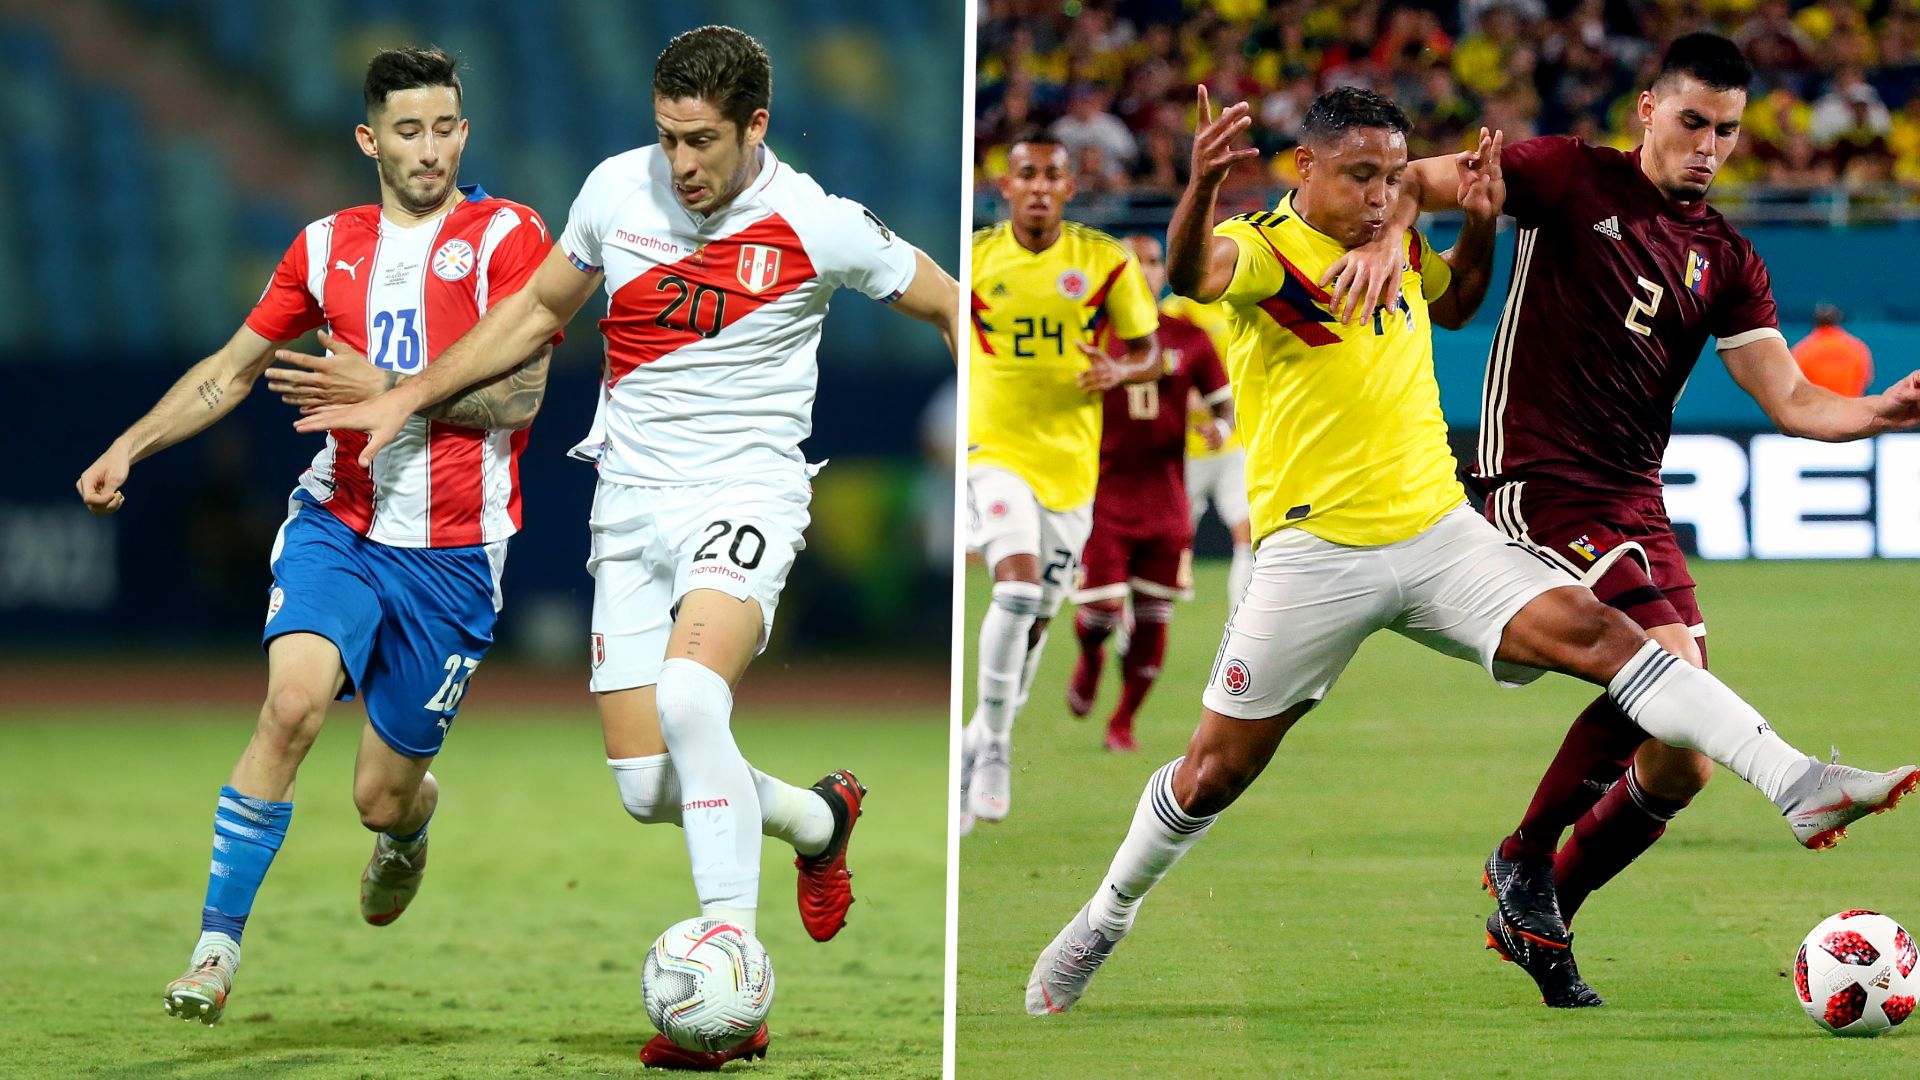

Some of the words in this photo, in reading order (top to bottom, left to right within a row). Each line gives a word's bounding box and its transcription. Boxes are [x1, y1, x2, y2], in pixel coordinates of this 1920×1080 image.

[616, 228, 678, 254] marathon
[1593, 223, 1622, 241] adidas
[655, 275, 727, 339] 20
[1624, 275, 1664, 337] 2
[373, 308, 420, 370] 23
[1014, 317, 1063, 357] 24
[693, 520, 767, 570] 20
[688, 565, 746, 583] marathon
[424, 653, 482, 711] 23
[1868, 965, 1891, 986] adidas
